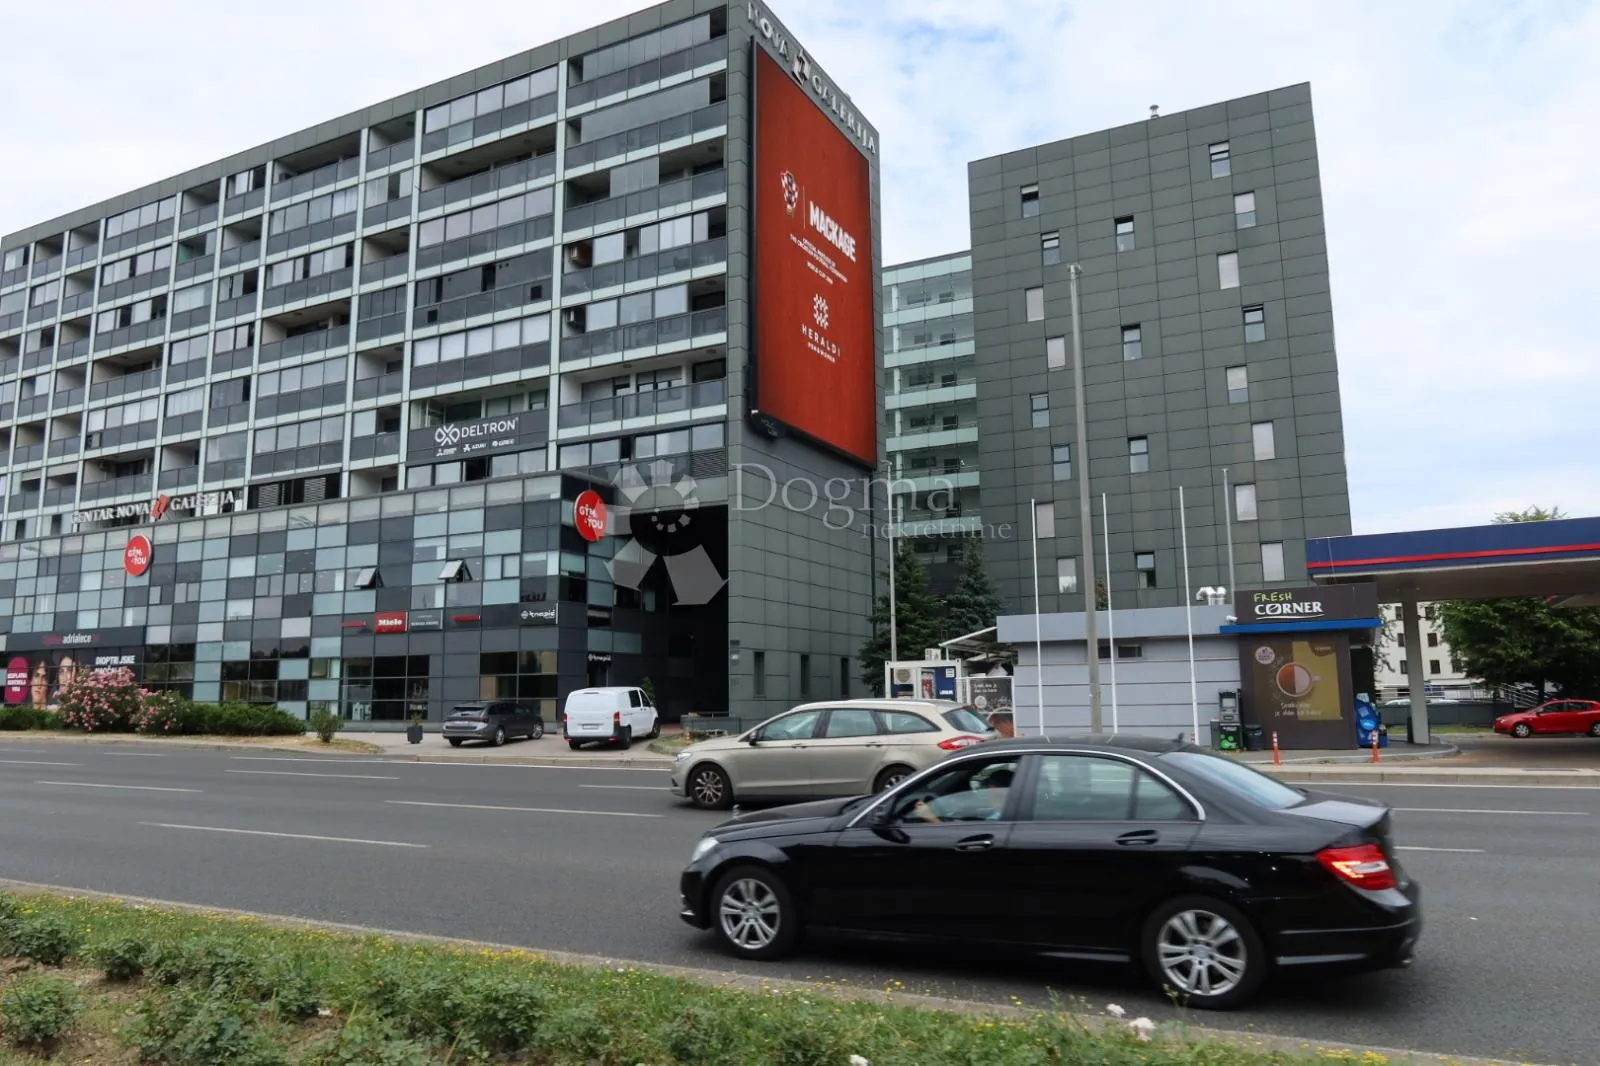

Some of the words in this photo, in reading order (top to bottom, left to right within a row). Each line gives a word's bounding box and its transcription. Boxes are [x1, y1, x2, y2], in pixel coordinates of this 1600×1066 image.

[748, 1, 789, 59] NOVA
[809, 200, 857, 263] MACKAGE
[461, 419, 516, 438] DELTRON
[115, 502, 150, 519] NOVA
[1254, 592, 1293, 602] FRESH
[1254, 602, 1324, 615] CORNER
[378, 618, 403, 626] Miele
